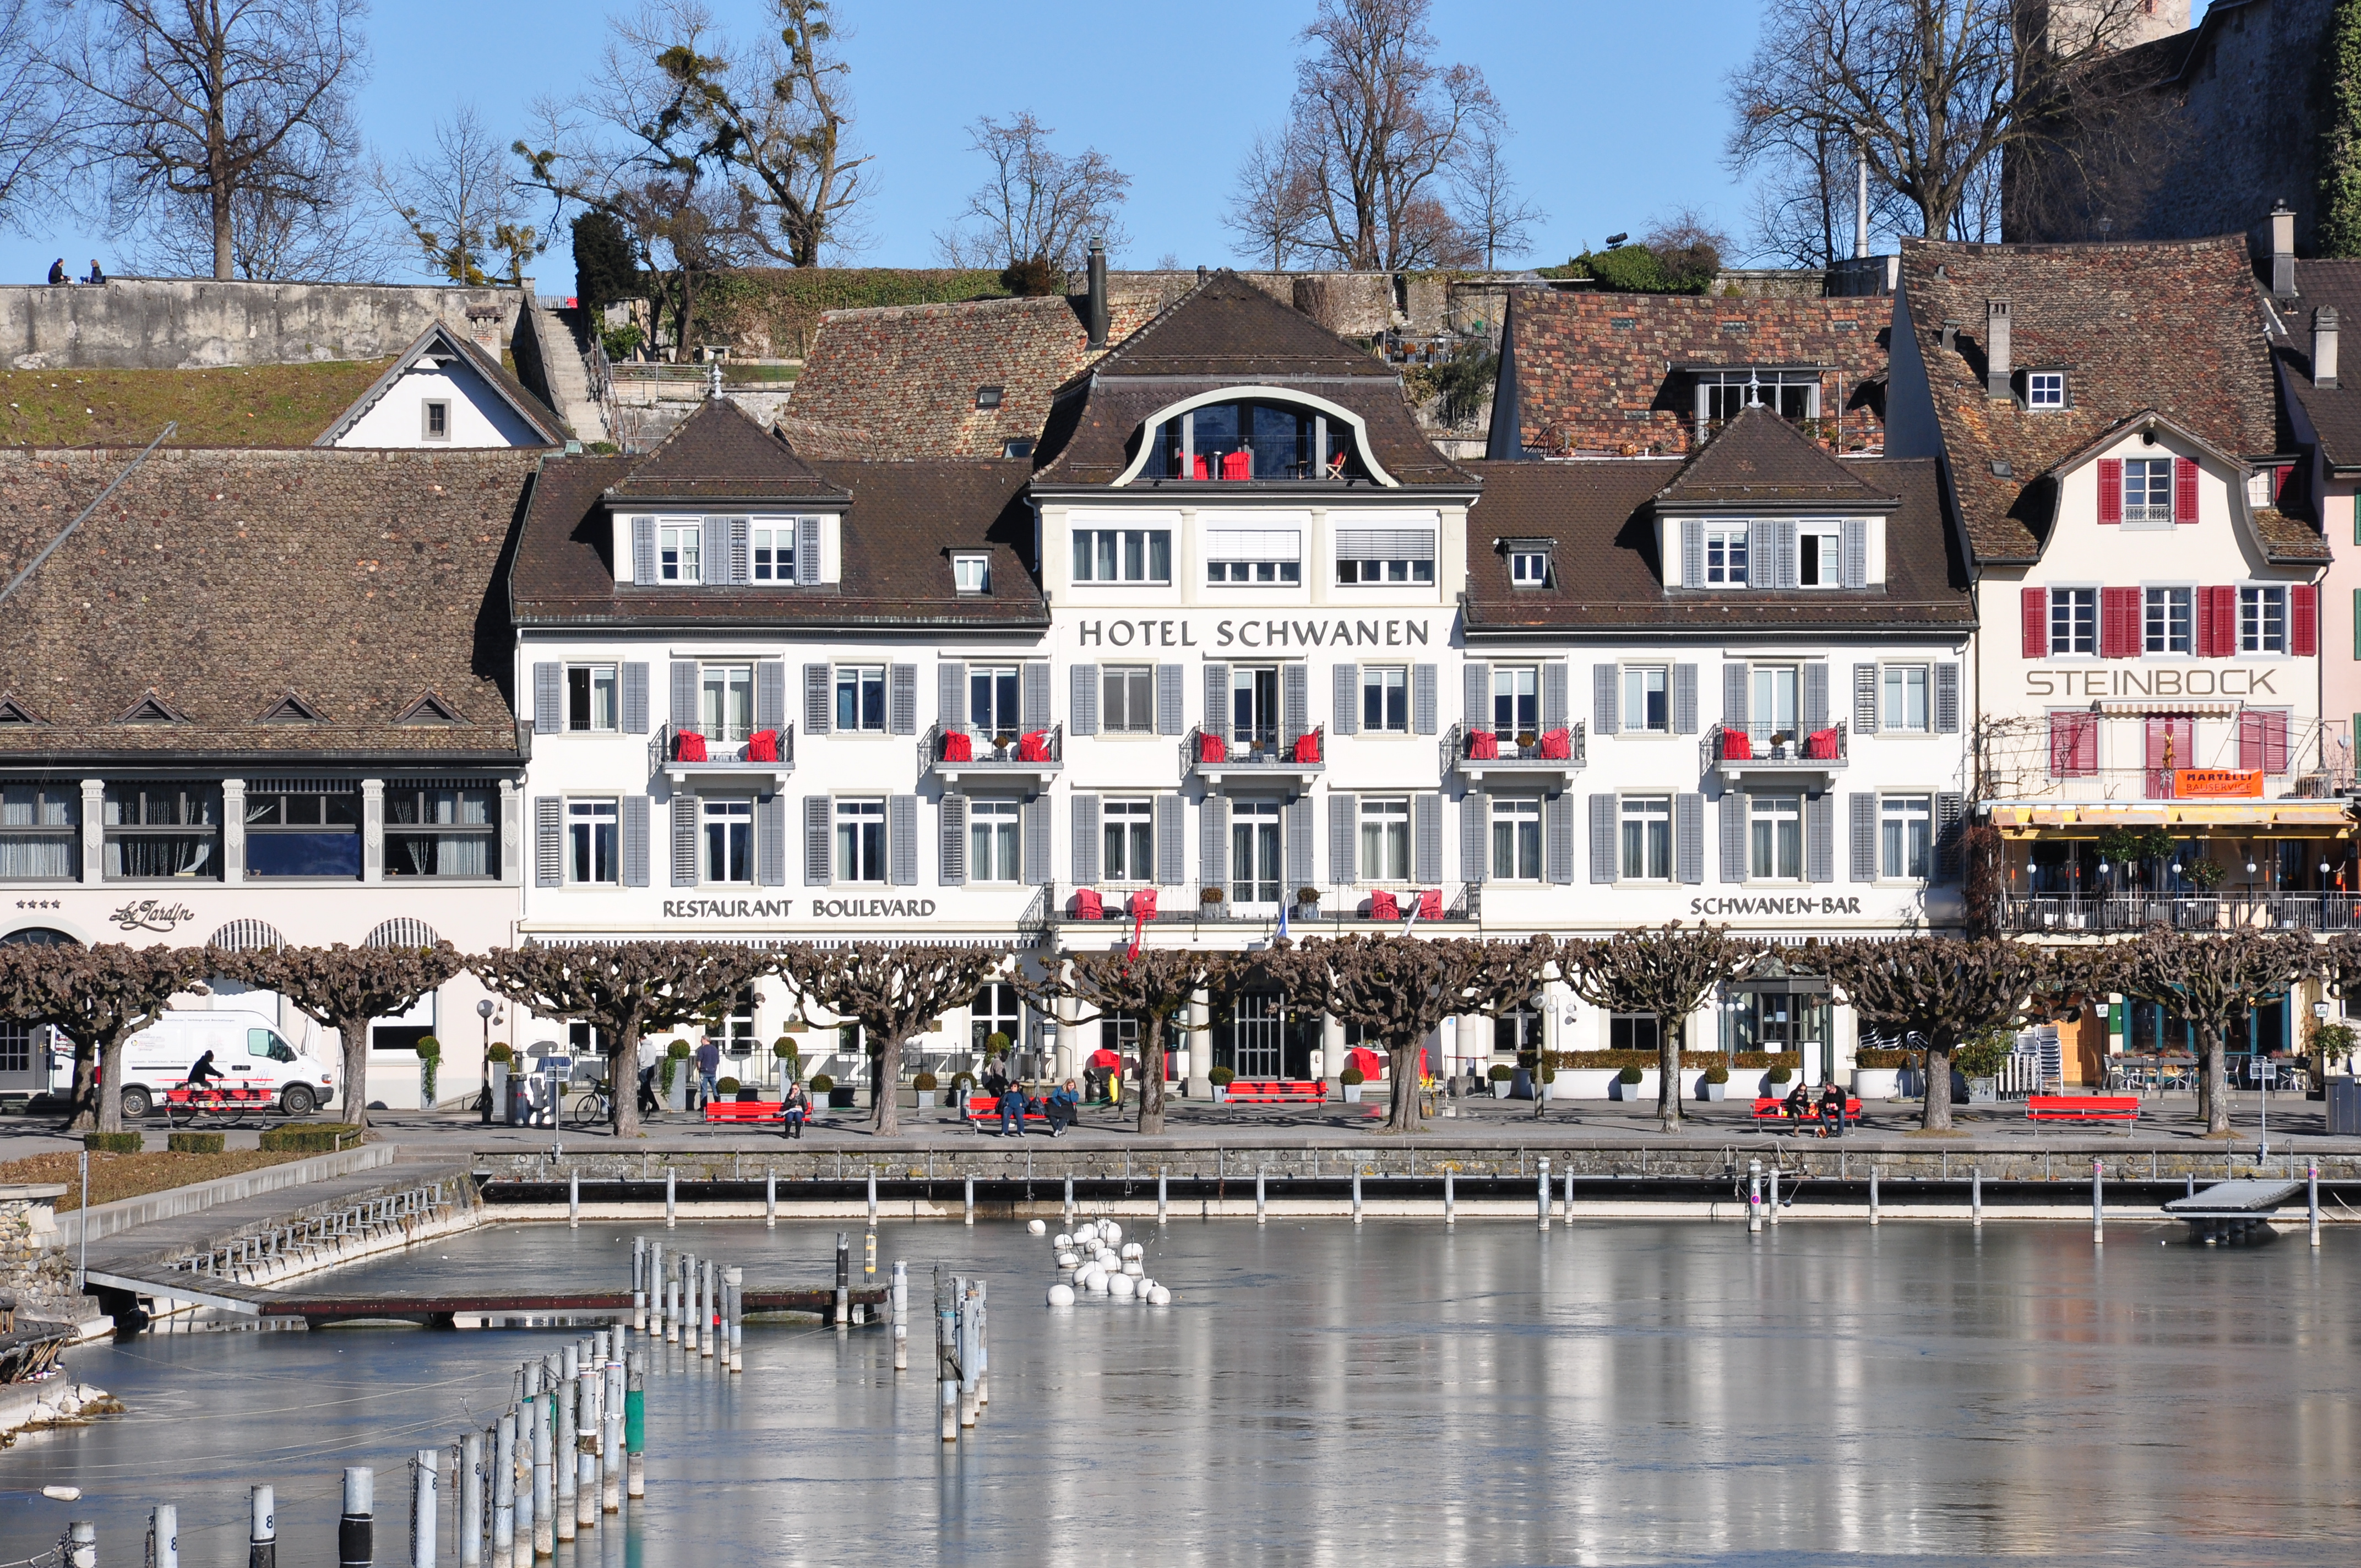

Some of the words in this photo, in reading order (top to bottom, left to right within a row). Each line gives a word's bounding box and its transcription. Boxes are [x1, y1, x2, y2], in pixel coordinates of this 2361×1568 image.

[1079, 620, 1198, 646] HOTEL
[1216, 620, 1429, 647] SCHWANEN
[2026, 669, 2277, 695] STEINBOCK
[2186, 783, 2252, 791] BAUSERVICE
[108, 900, 139, 921] Le
[663, 900, 793, 917] RESTAURANT
[812, 900, 935, 917] BOULEVARD
[1690, 897, 1862, 915] SCHWANEN-BAR
[119, 899, 195, 933] Jardin
[475, 1462, 480, 1475] 8
[432, 1477, 437, 1490] 8
[266, 1515, 273, 1529] 8
[171, 1537, 177, 1551] 8
